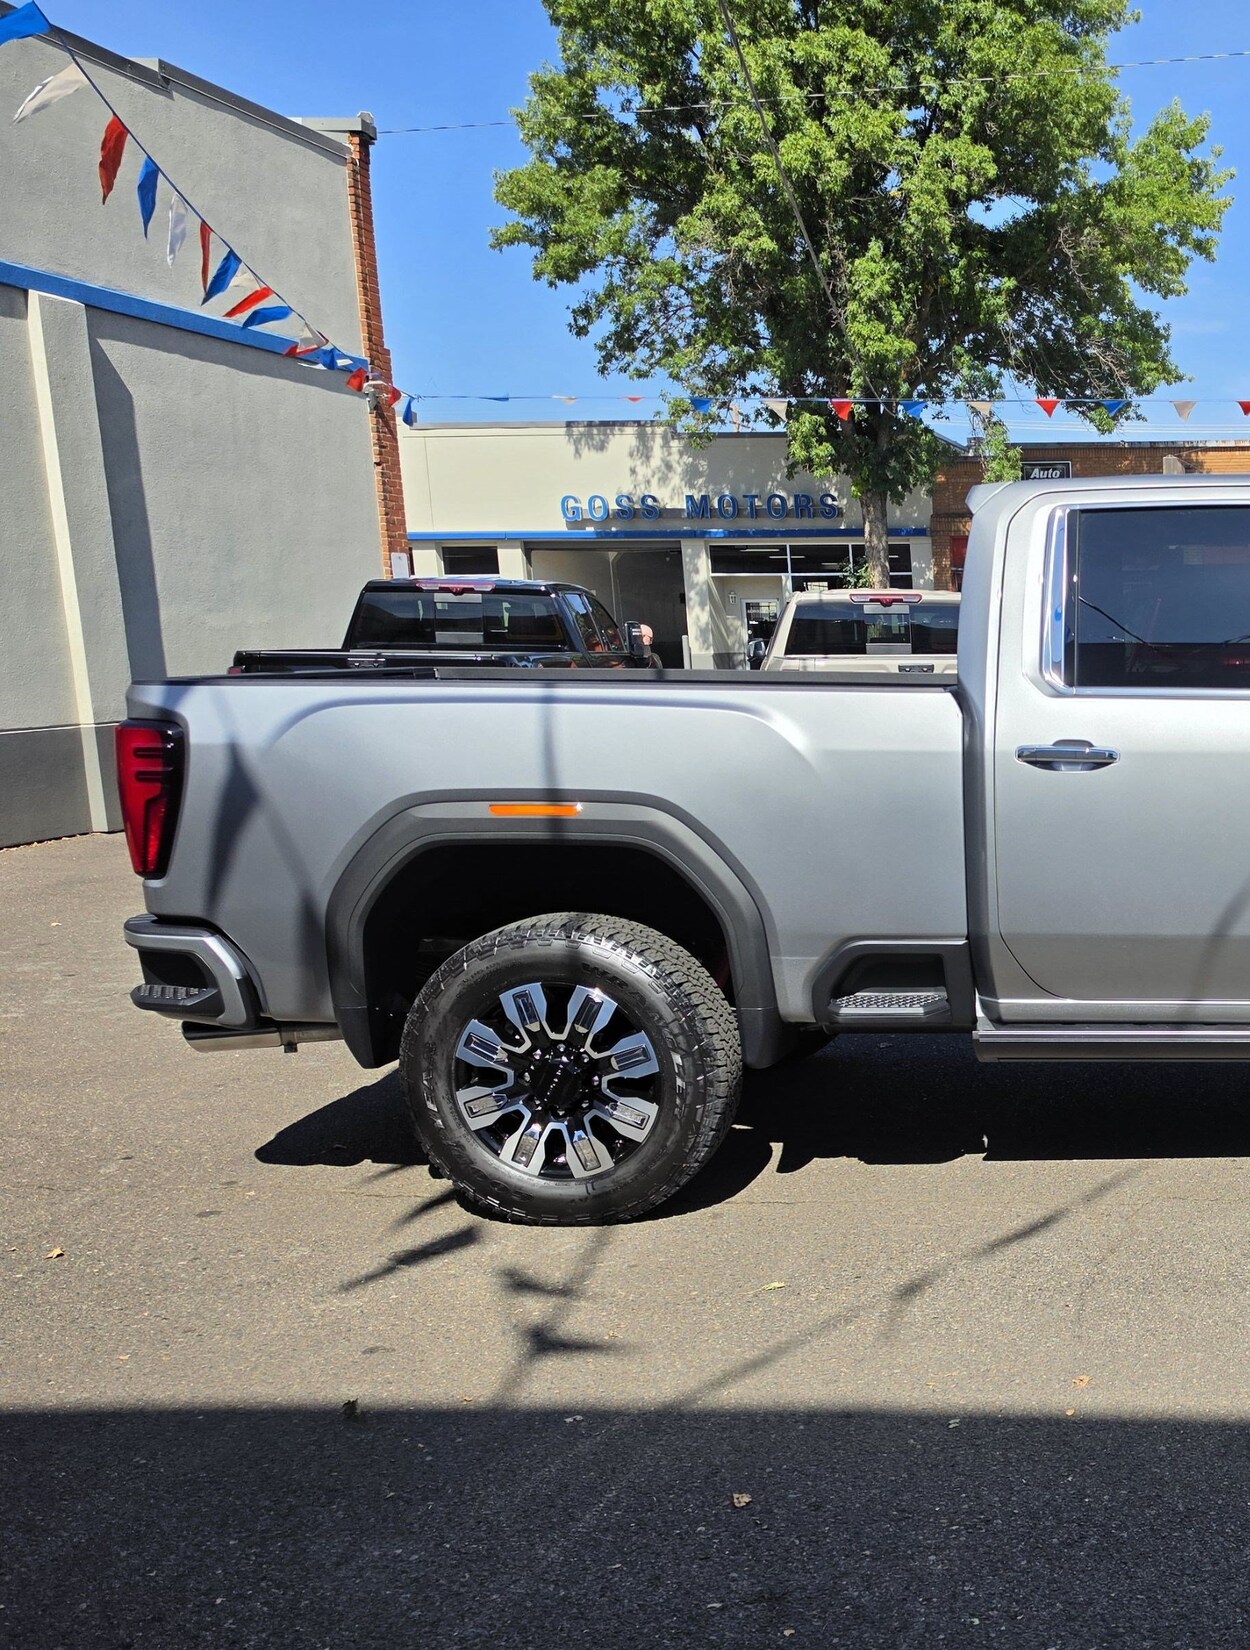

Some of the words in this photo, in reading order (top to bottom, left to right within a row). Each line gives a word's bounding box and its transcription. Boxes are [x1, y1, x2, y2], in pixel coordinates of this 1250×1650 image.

[1030, 468, 1061, 479] Auto
[560, 494, 661, 521] GOSS
[685, 493, 841, 521] MOTORS
